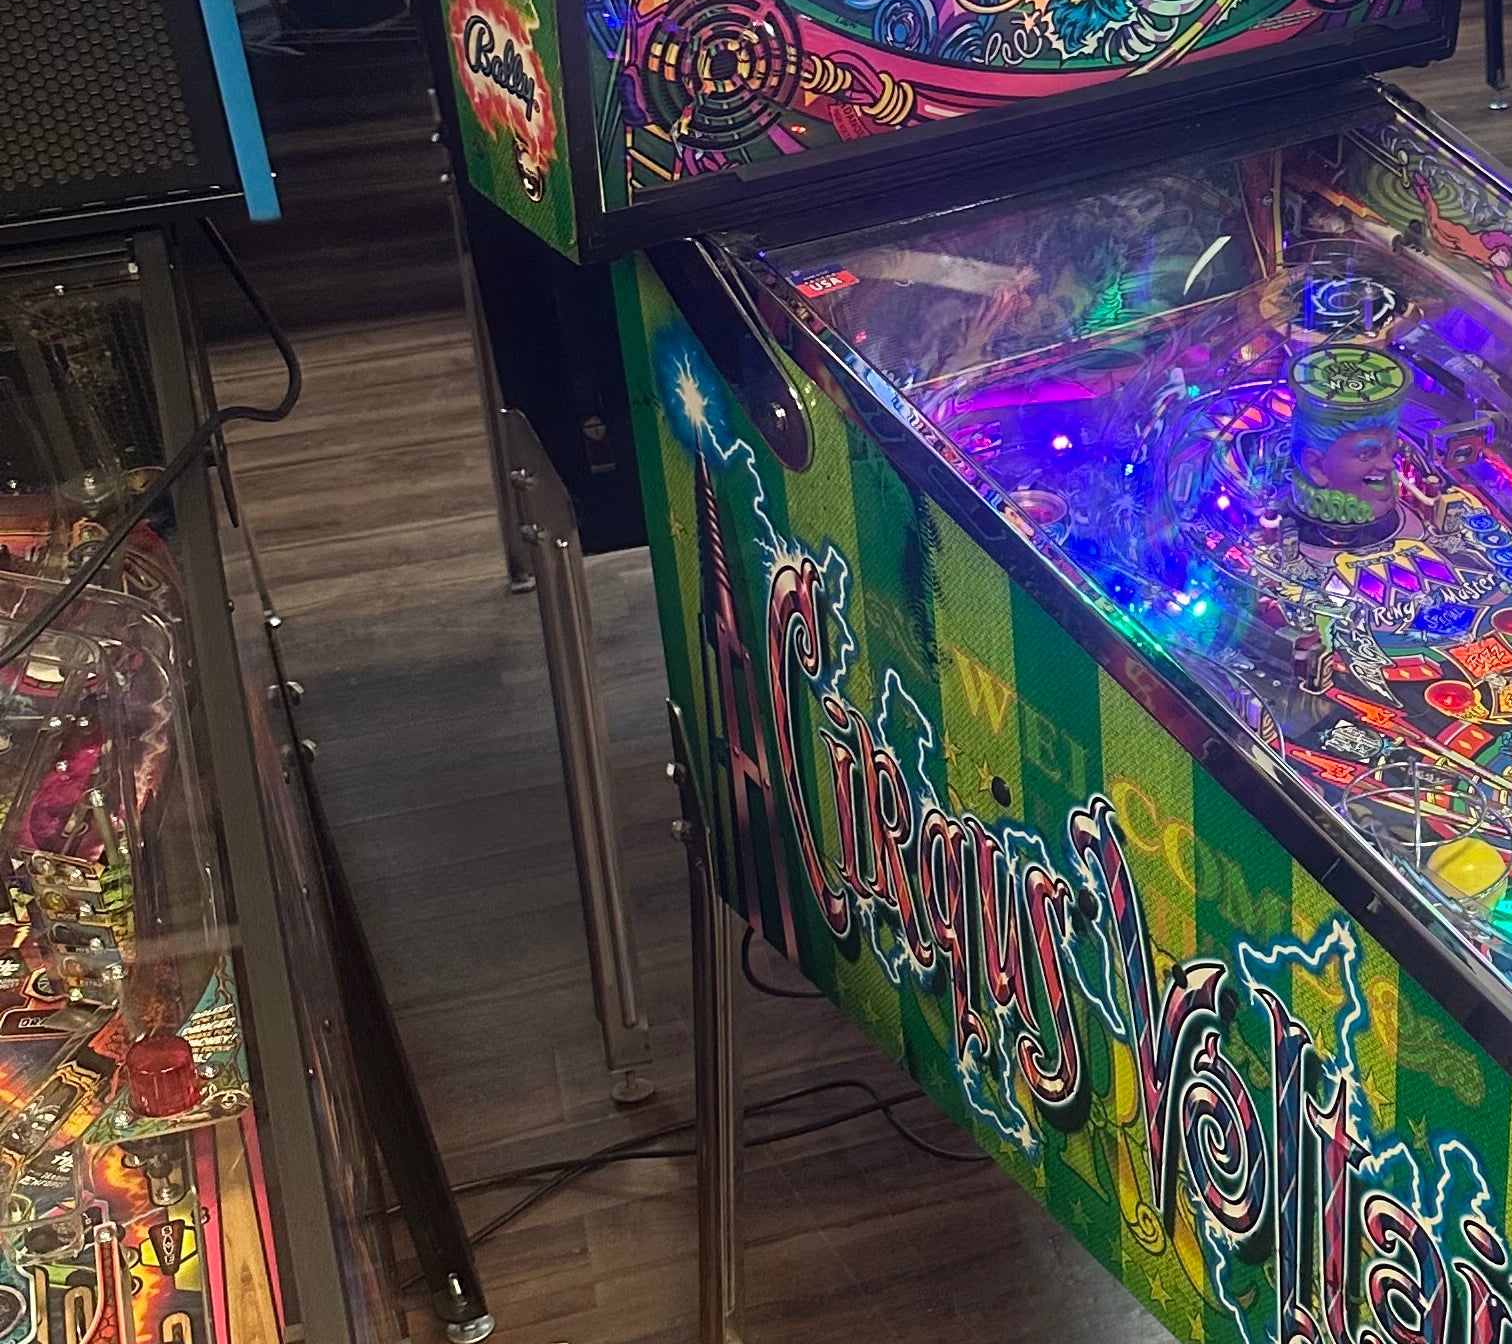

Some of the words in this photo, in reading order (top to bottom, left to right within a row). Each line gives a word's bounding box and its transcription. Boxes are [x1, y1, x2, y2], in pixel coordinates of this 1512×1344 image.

[464, 15, 535, 122] Bally
[809, 276, 843, 292] USA
[18, 1017, 49, 1029] DRA
